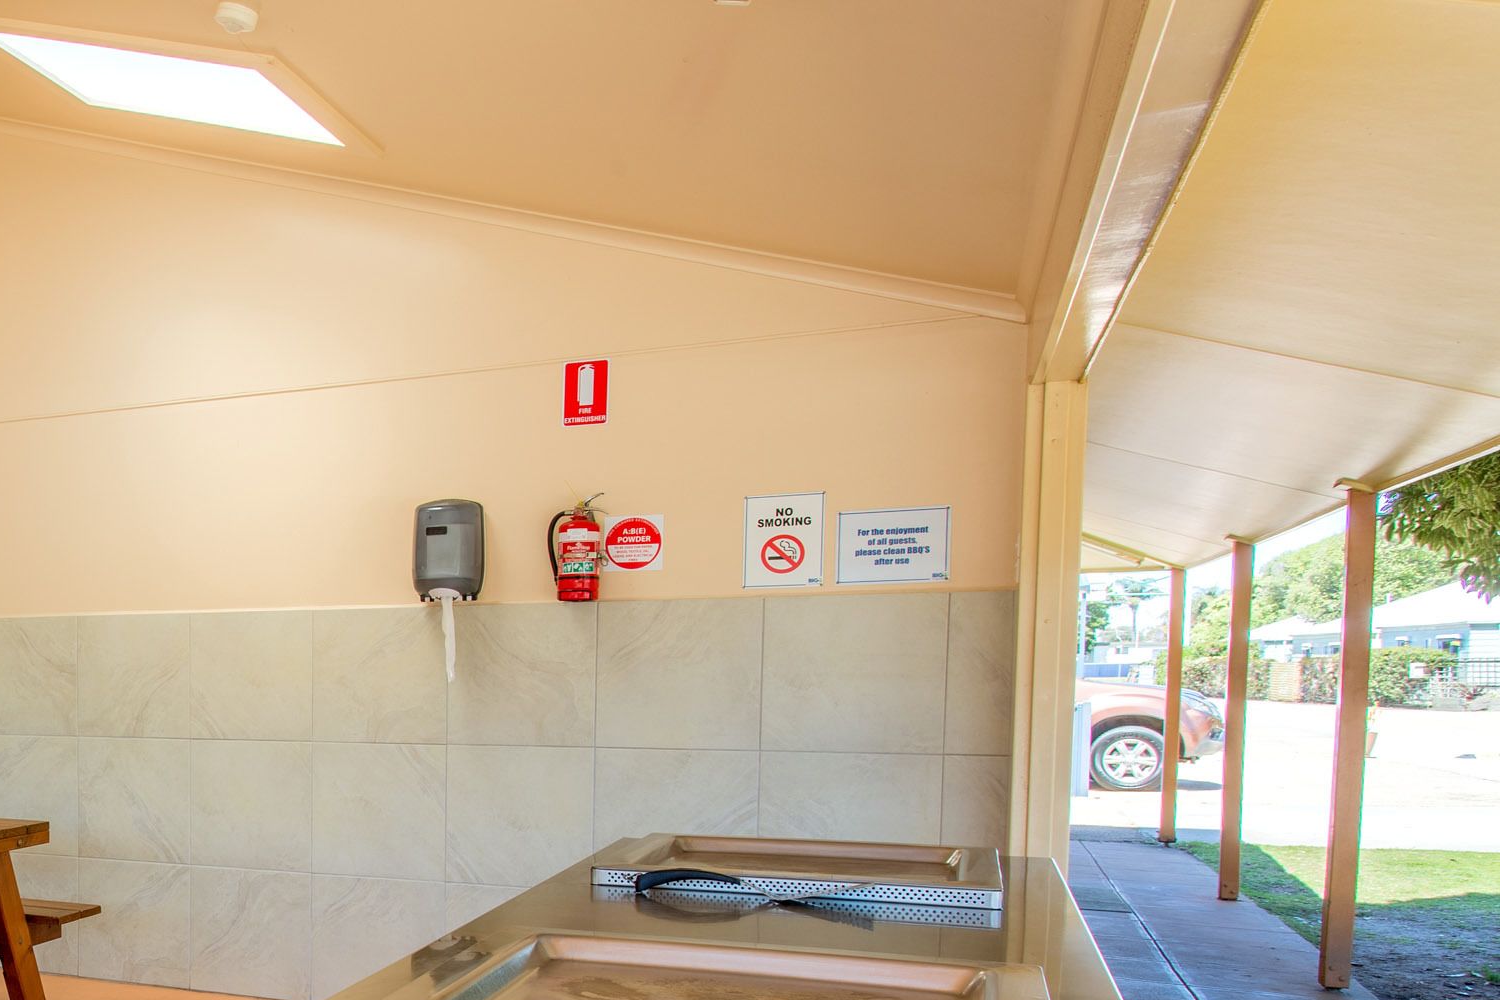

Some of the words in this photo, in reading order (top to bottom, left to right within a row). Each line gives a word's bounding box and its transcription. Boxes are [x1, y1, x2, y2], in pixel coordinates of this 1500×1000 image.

[564, 414, 606, 424] EXTINGUISHER
[775, 507, 793, 517] NO
[757, 516, 812, 528] SMOKING
[857, 528, 870, 536] For
[871, 528, 884, 536] the
[885, 526, 929, 536] enjoyment
[617, 535, 651, 543] POWDER
[867, 538, 876, 546] of
[855, 548, 882, 557] please
[883, 547, 906, 555] clean
[874, 557, 893, 566] after
[894, 557, 910, 565] use
